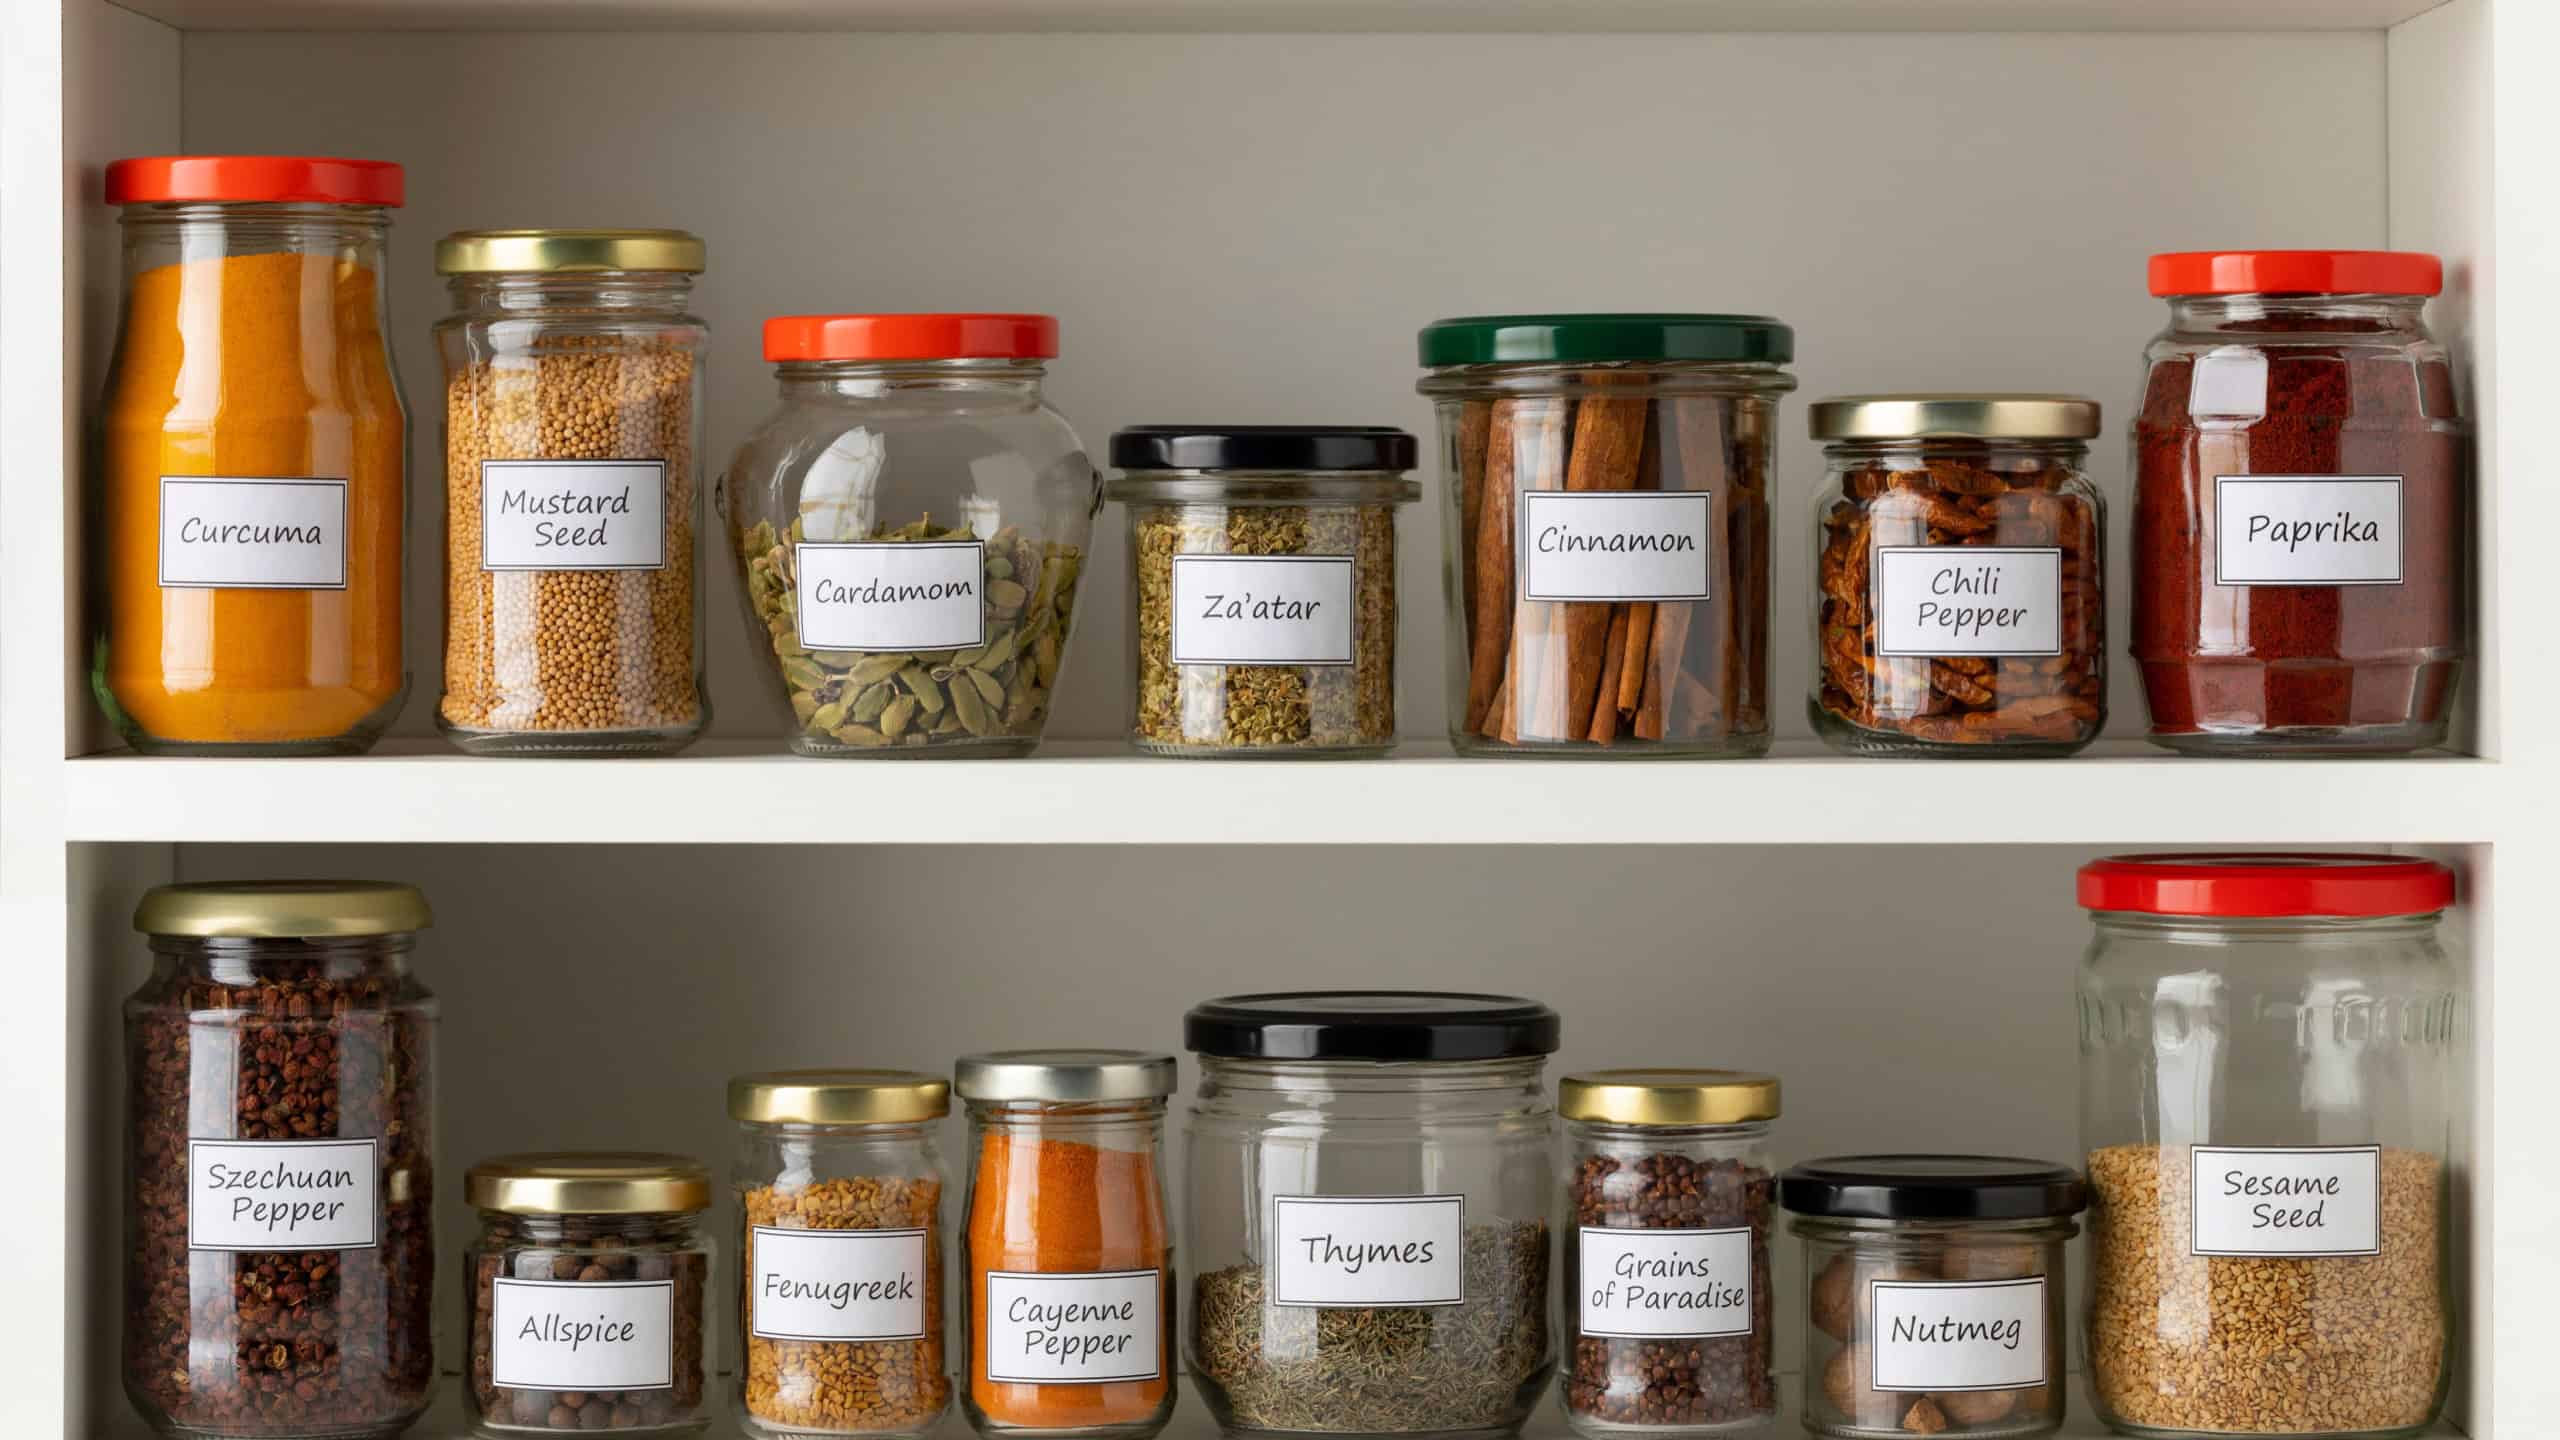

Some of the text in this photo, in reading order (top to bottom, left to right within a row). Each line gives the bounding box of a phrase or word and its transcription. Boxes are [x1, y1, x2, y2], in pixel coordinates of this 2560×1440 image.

[502, 485, 631, 515] Mustard
[181, 515, 322, 545] Curcuma
[535, 517, 608, 547] Seed
[1538, 524, 1696, 553] Cinnamon
[2248, 511, 2379, 552] Paprika
[815, 577, 973, 604] Cardamom
[1931, 566, 2001, 596] Chili
[1918, 602, 2028, 637] Pepper
[209, 1161, 355, 1190] Szechuan
[2223, 1170, 2340, 1196] Sesame
[232, 1196, 345, 1233] Pepper
[2252, 1199, 2325, 1229] Seed
[1301, 1233, 1434, 1274] Thymes
[1615, 1251, 1709, 1280] Grains
[765, 1271, 915, 1310] Fenugreek
[1592, 1280, 1745, 1310] of Paradise
[1008, 1296, 1135, 1332] Cayenne
[519, 1313, 635, 1352] Allspice
[1025, 1330, 1133, 1365] Pepper
[1891, 1315, 2022, 1351] Nutmeg
